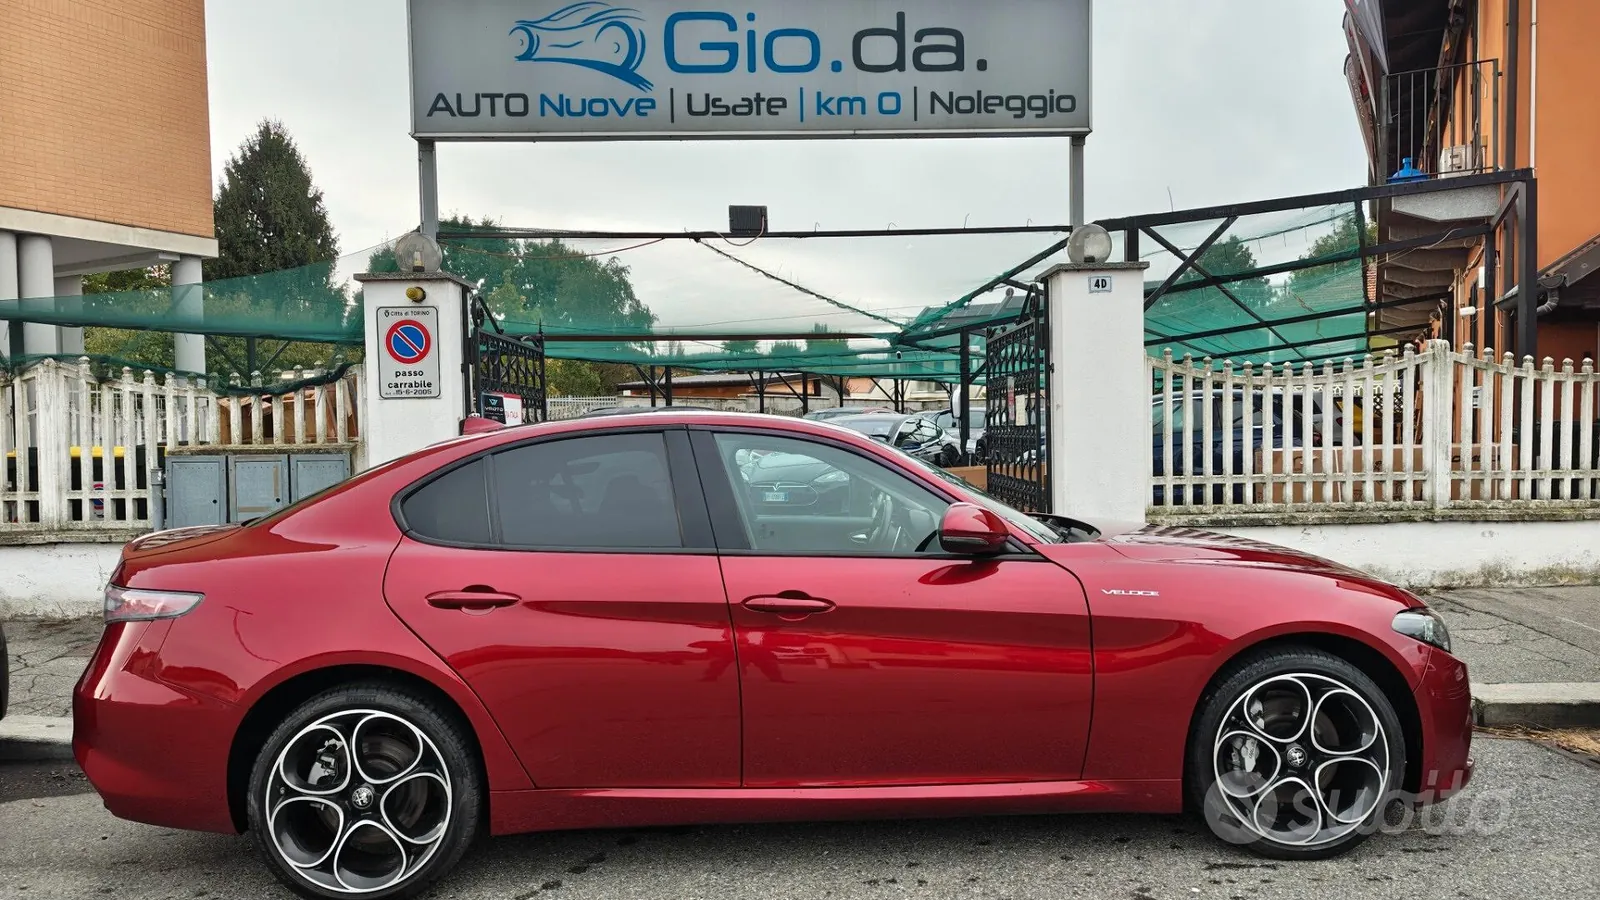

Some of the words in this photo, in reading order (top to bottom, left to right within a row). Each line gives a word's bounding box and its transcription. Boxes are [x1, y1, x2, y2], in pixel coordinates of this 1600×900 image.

[426, 92, 529, 118] AUTO
[539, 92, 656, 118] Nuove
[686, 92, 787, 117] Usate
[816, 90, 867, 117] km
[929, 88, 1077, 120] Noleggio
[1094, 278, 1107, 289] 4D
[394, 370, 424, 379] passo
[387, 380, 433, 389] carrabile
[1101, 588, 1160, 597] VELOCE
